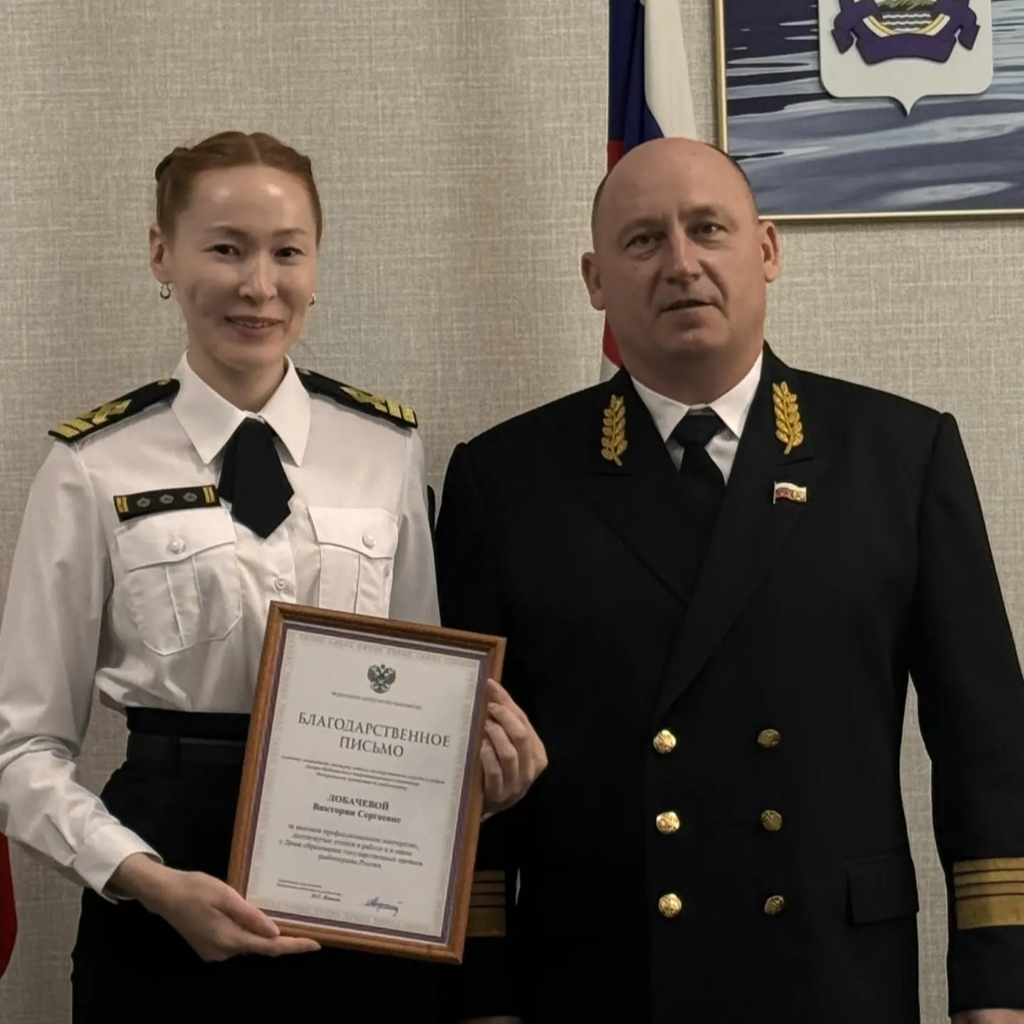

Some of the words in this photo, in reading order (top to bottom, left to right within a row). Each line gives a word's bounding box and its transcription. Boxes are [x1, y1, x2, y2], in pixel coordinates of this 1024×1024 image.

[298, 712, 451, 748] БЛАГОДАРСТВЕННОЕ
[339, 736, 405, 758] ПИСЬМО
[327, 793, 390, 811] ЛОБАЧЕВОЙ
